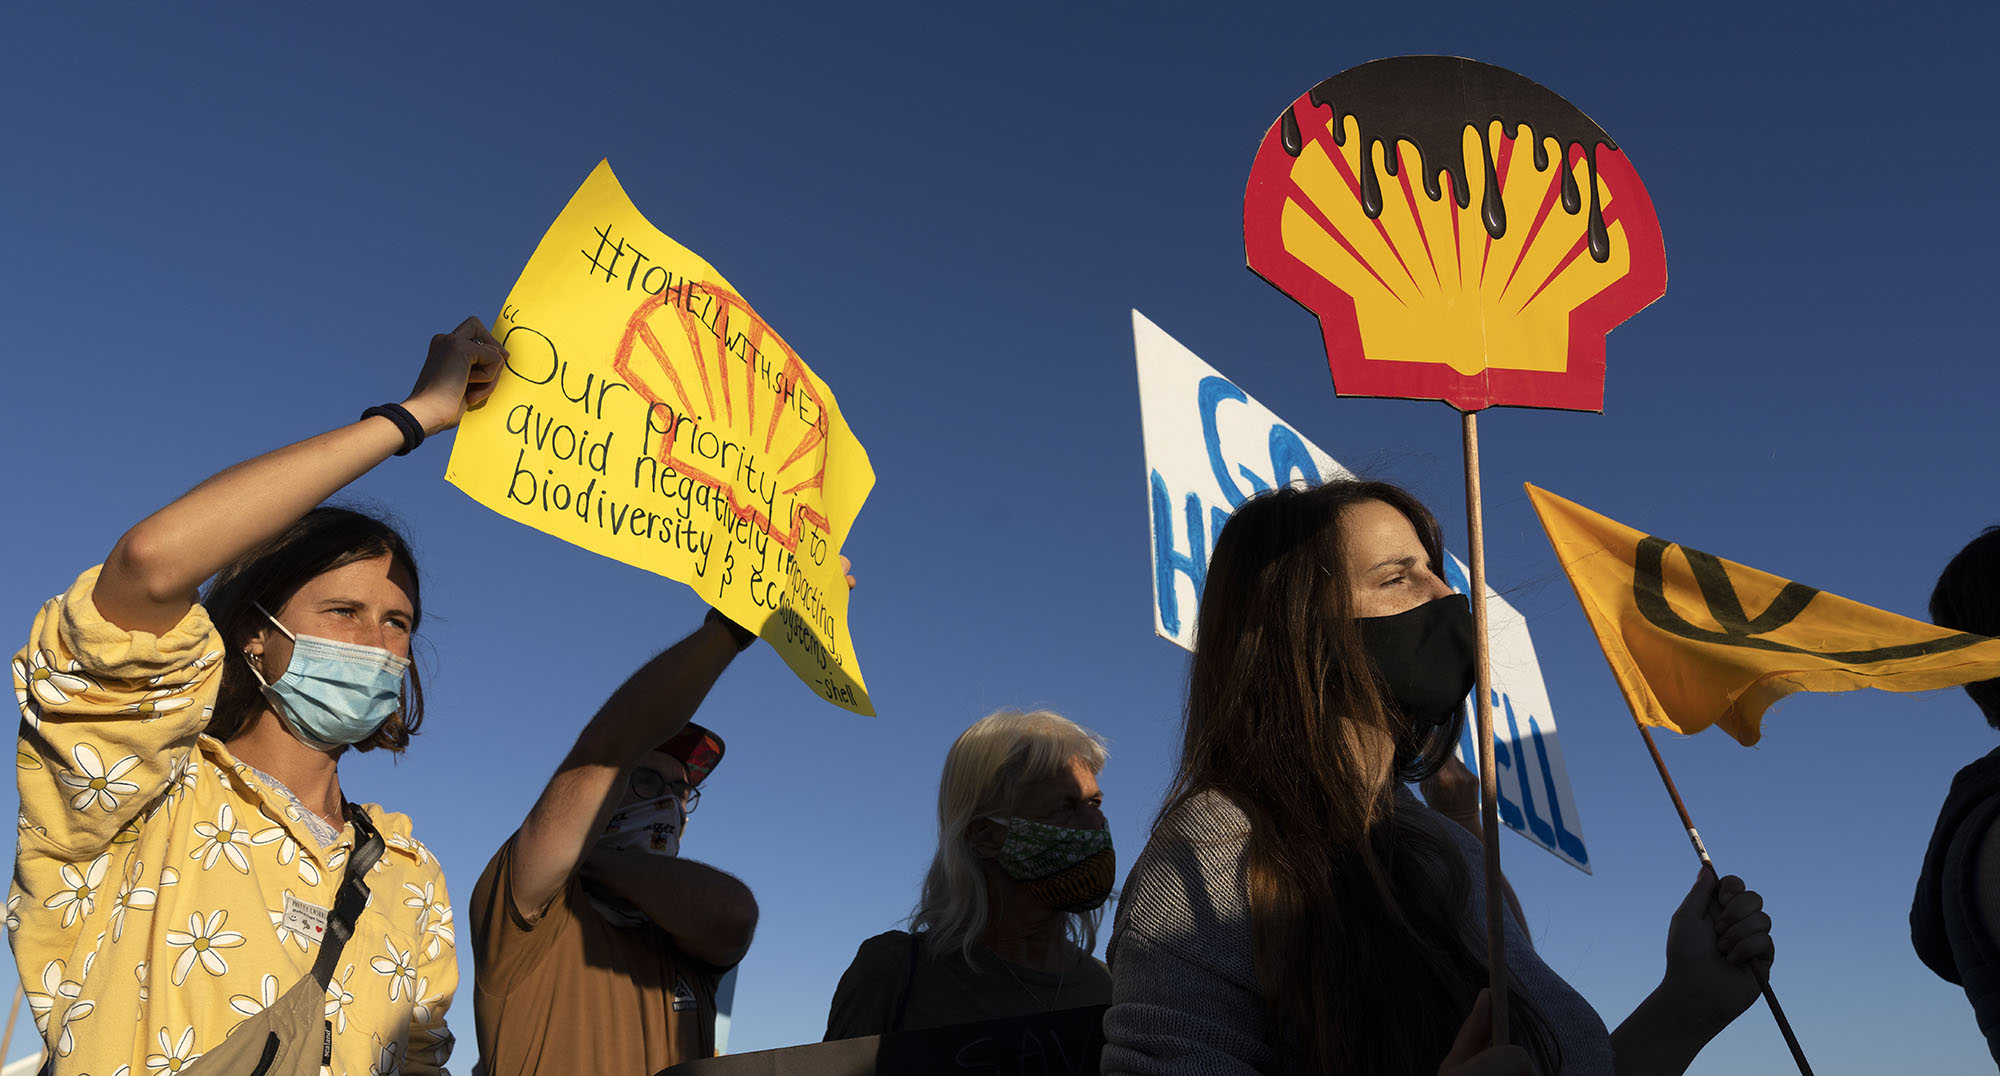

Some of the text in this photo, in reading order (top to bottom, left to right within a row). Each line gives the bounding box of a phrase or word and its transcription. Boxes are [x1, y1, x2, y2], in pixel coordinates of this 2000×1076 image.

[506, 405, 613, 475] avoid
[635, 455, 768, 573] negatively
[507, 449, 713, 577] biodiversity
[643, 401, 776, 535] priority
[789, 492, 808, 542] is
[810, 526, 827, 566] to
